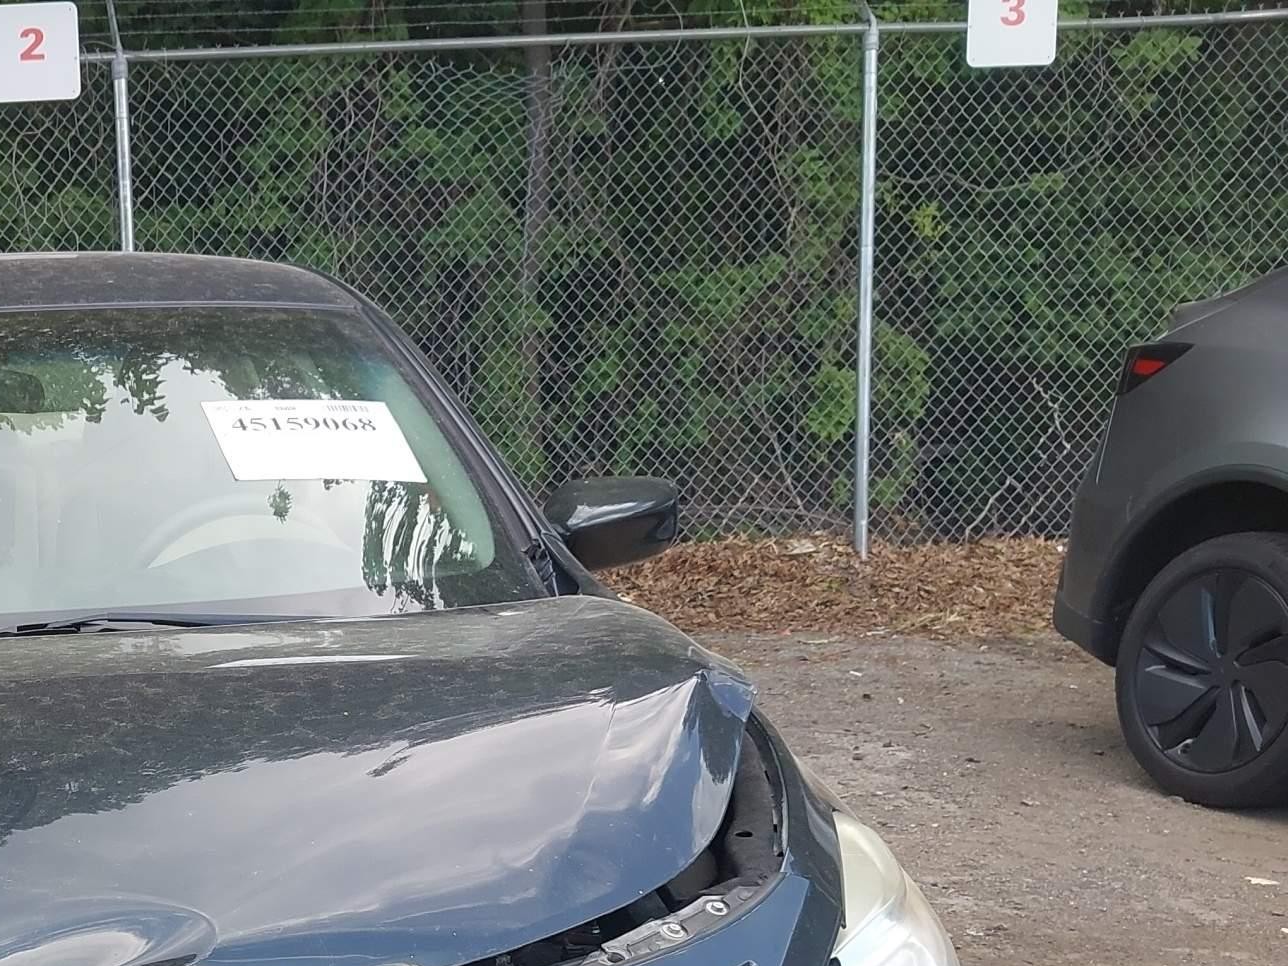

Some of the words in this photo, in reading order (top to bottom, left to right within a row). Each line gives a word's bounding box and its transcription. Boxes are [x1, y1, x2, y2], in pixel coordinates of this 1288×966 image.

[999, 0, 1026, 27] 3
[19, 27, 46, 62] 2
[230, 416, 378, 433] 45159068
